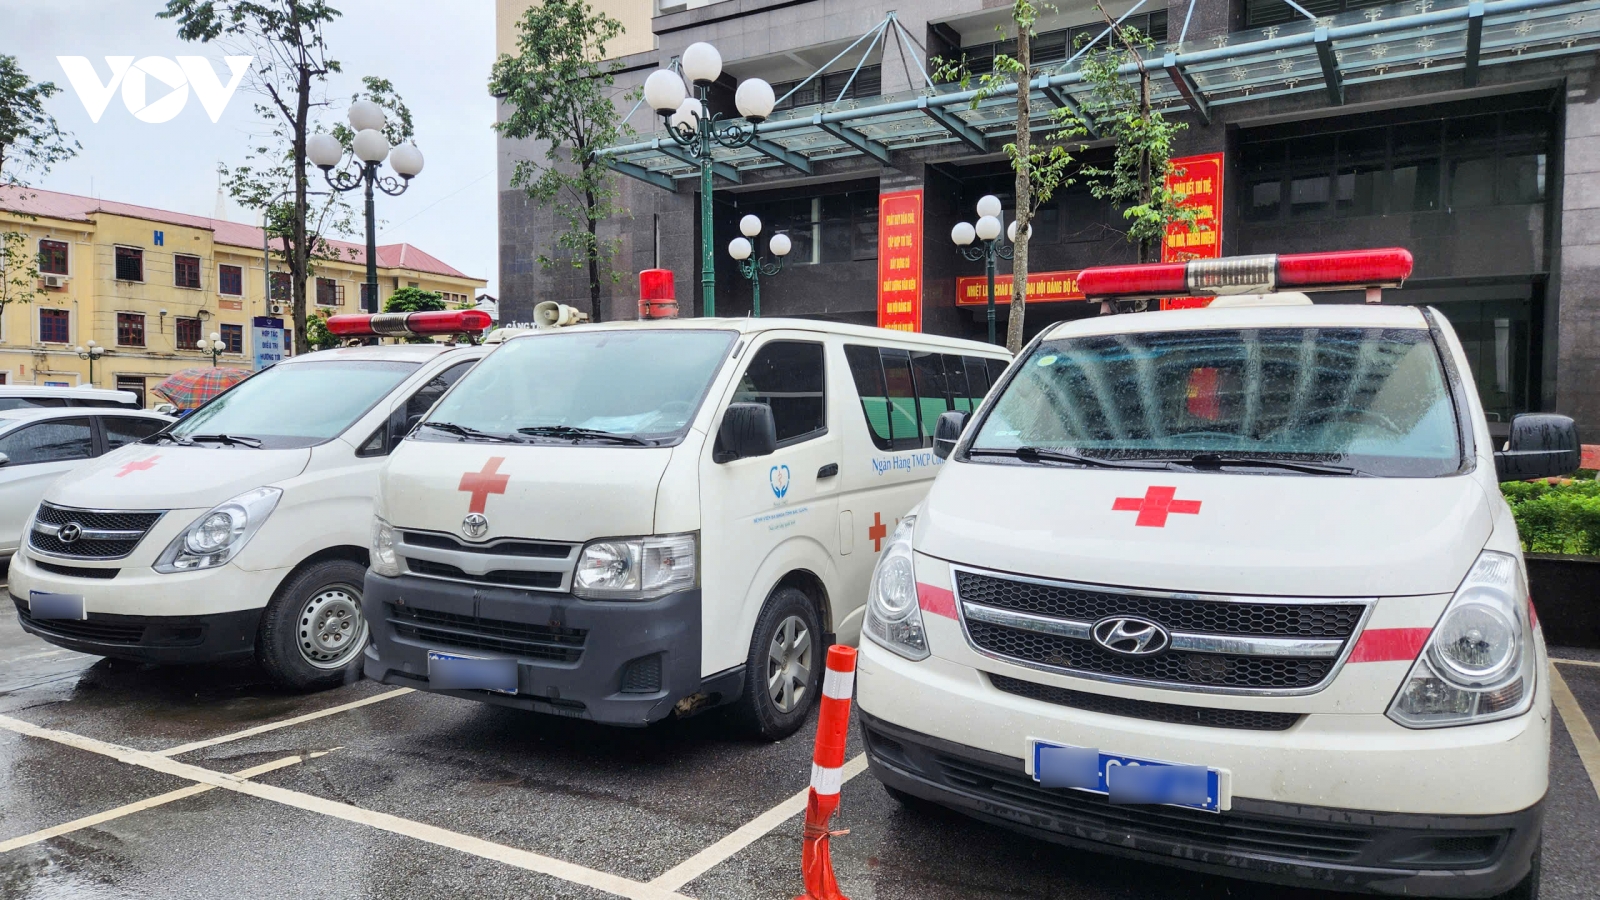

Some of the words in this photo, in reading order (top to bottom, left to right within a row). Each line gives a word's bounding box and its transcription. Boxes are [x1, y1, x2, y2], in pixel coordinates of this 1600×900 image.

[154, 230, 164, 247] H
[967, 283, 982, 300] NHIỆT
[1036, 279, 1046, 297] HỘI
[1047, 277, 1062, 294] ĐẢNG
[1063, 278, 1071, 295] BỘ
[893, 454, 911, 473] Hàng
[912, 452, 930, 468] TMCP
